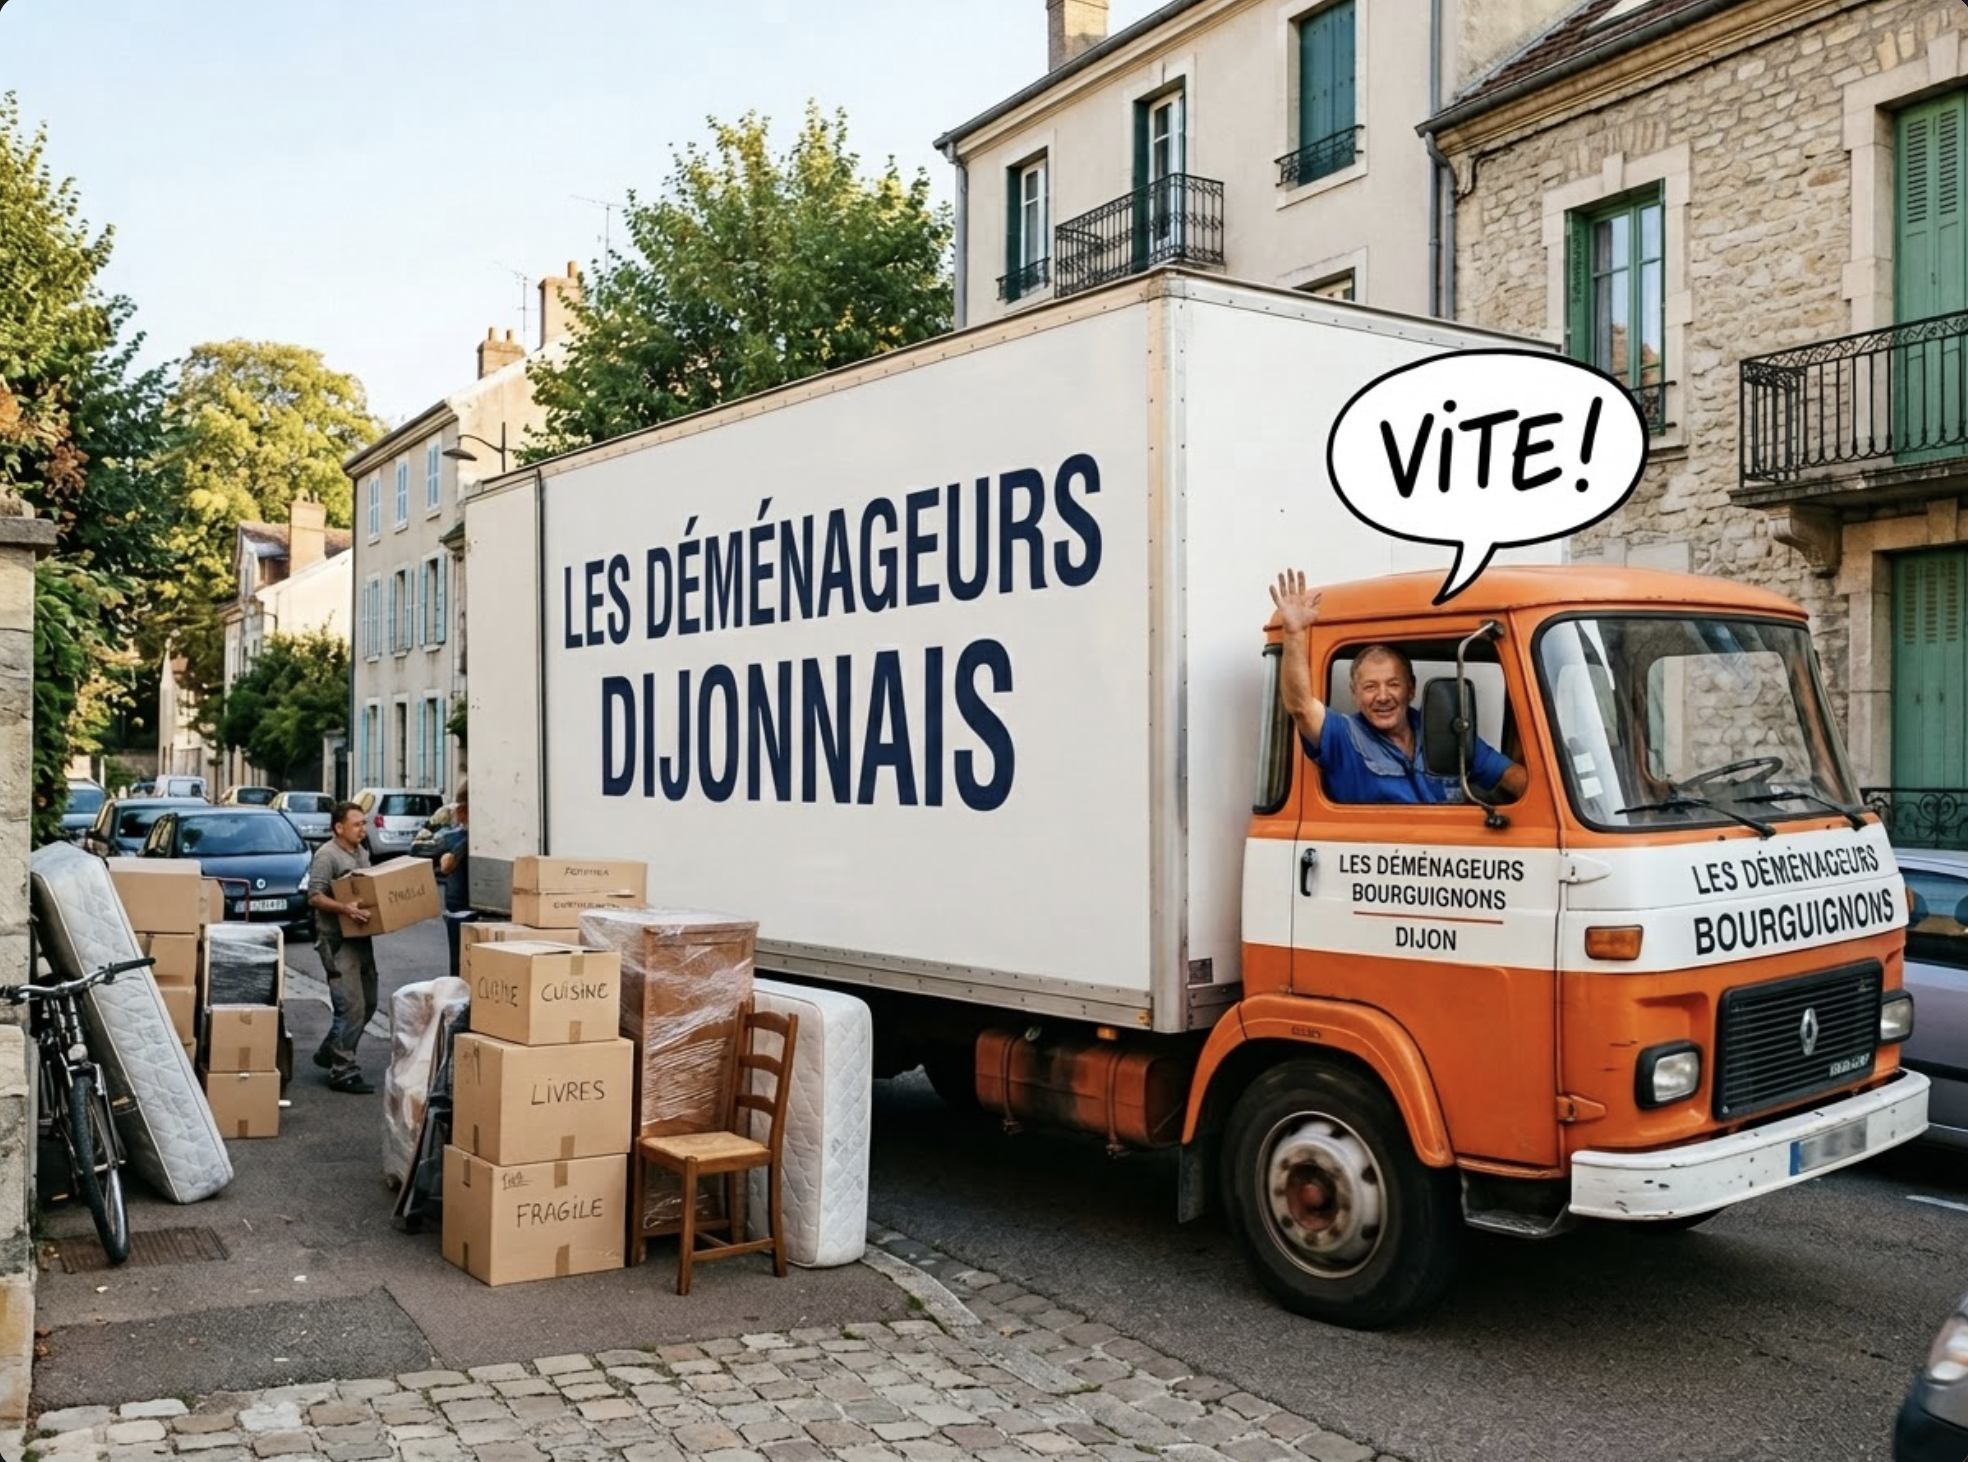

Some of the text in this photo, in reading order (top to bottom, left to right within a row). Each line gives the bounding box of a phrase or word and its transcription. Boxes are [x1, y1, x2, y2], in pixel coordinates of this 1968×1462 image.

[564, 453, 1103, 649] LES DÉMÉNAGEURS
[602, 638, 1015, 812] DIJONNAIS
[1339, 854, 1372, 874] LES
[1691, 861, 1738, 895] LES
[1352, 883, 1507, 911] BOURGUIGNONS
[1395, 926, 1457, 951] DIJON
[1693, 888, 1895, 956] BOURGUIGNONS
